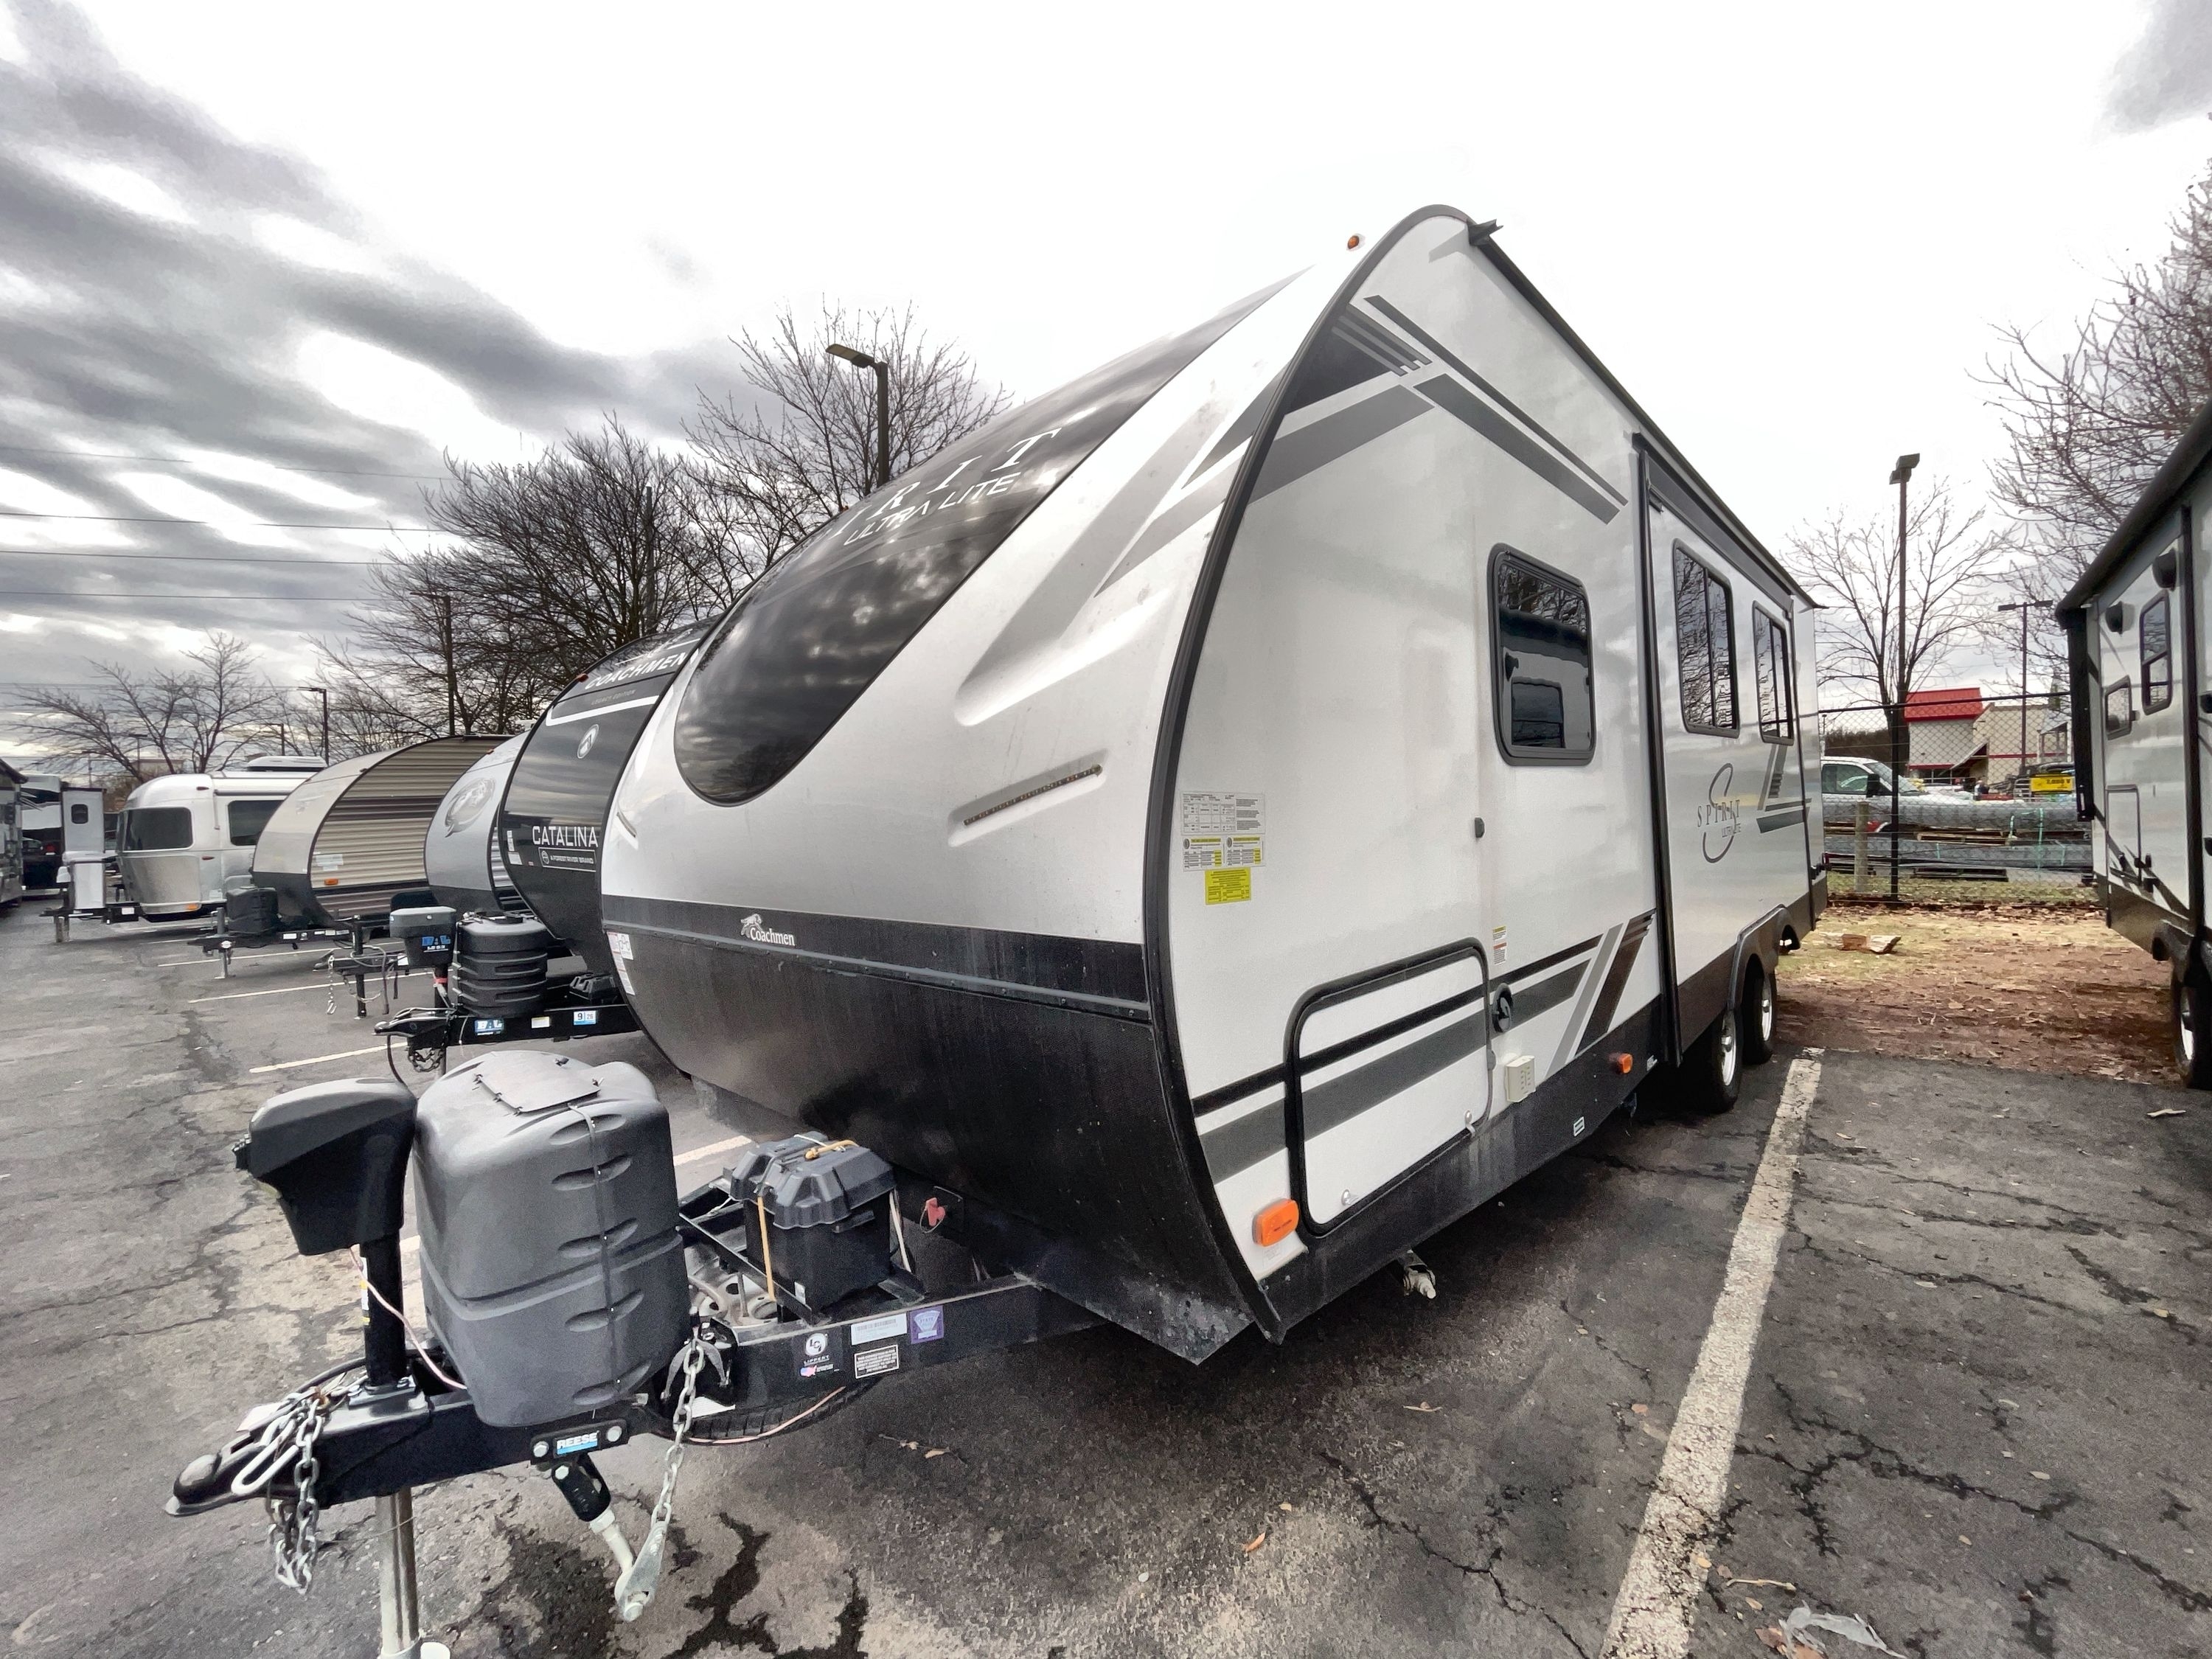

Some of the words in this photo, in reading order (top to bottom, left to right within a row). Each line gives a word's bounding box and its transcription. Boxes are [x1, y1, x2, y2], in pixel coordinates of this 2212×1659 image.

[844, 500, 931, 546] ULTRA
[937, 472, 1022, 510] LITE
[584, 651, 687, 690] COACHMEN
[1697, 799, 1741, 827] SPIRIT
[532, 825, 599, 848] CATALINA
[750, 928, 796, 947] Coachmen
[577, 1012, 583, 1020] 9
[556, 1431, 598, 1450] REESE
